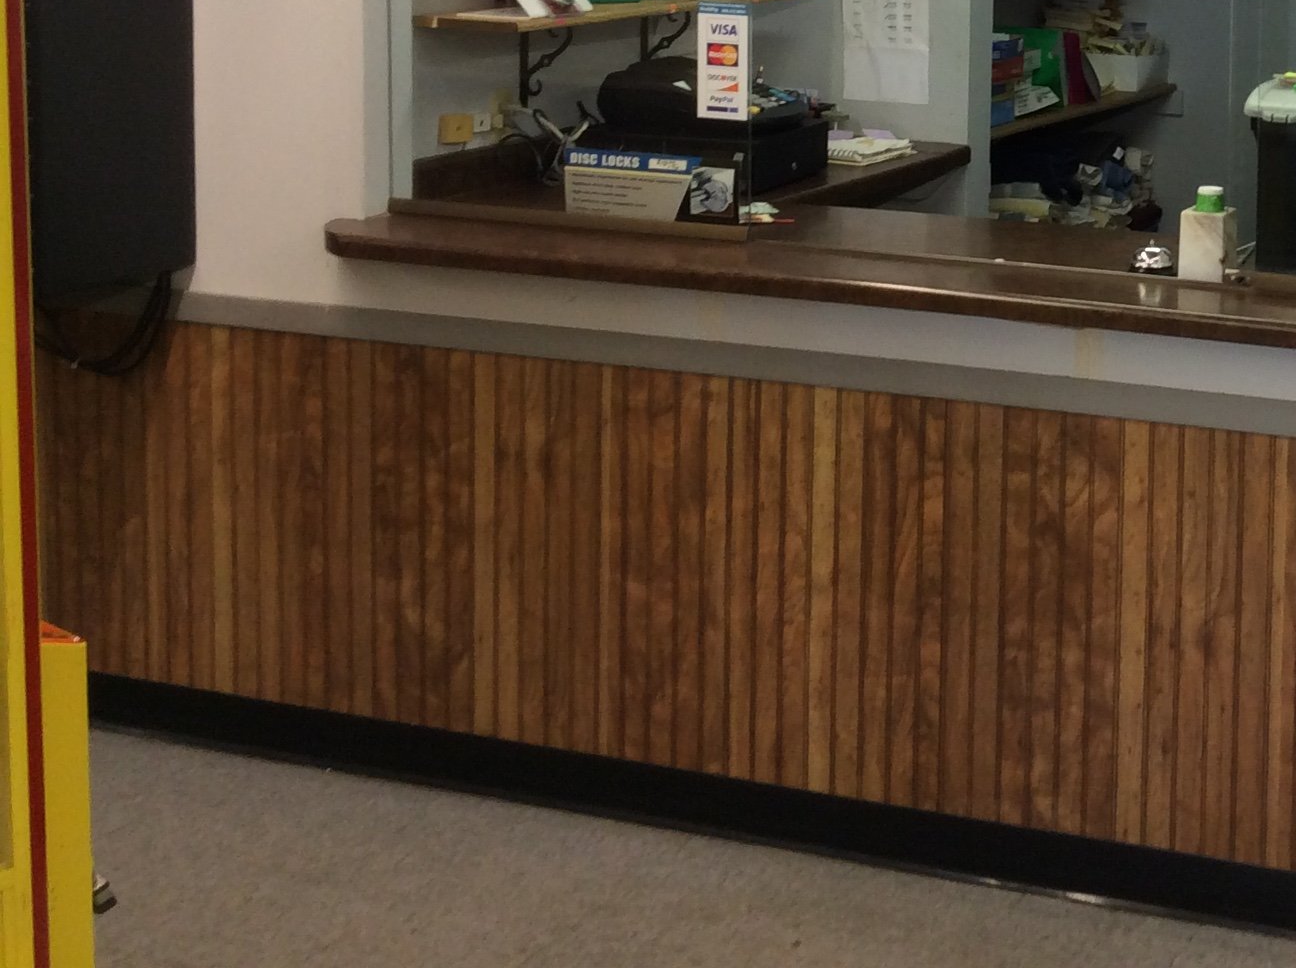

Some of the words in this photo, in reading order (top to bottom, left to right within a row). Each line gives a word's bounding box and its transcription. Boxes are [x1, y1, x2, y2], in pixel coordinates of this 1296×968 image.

[710, 23, 738, 36] VISA
[569, 151, 598, 165] DISC
[601, 153, 641, 169] LOCKS
